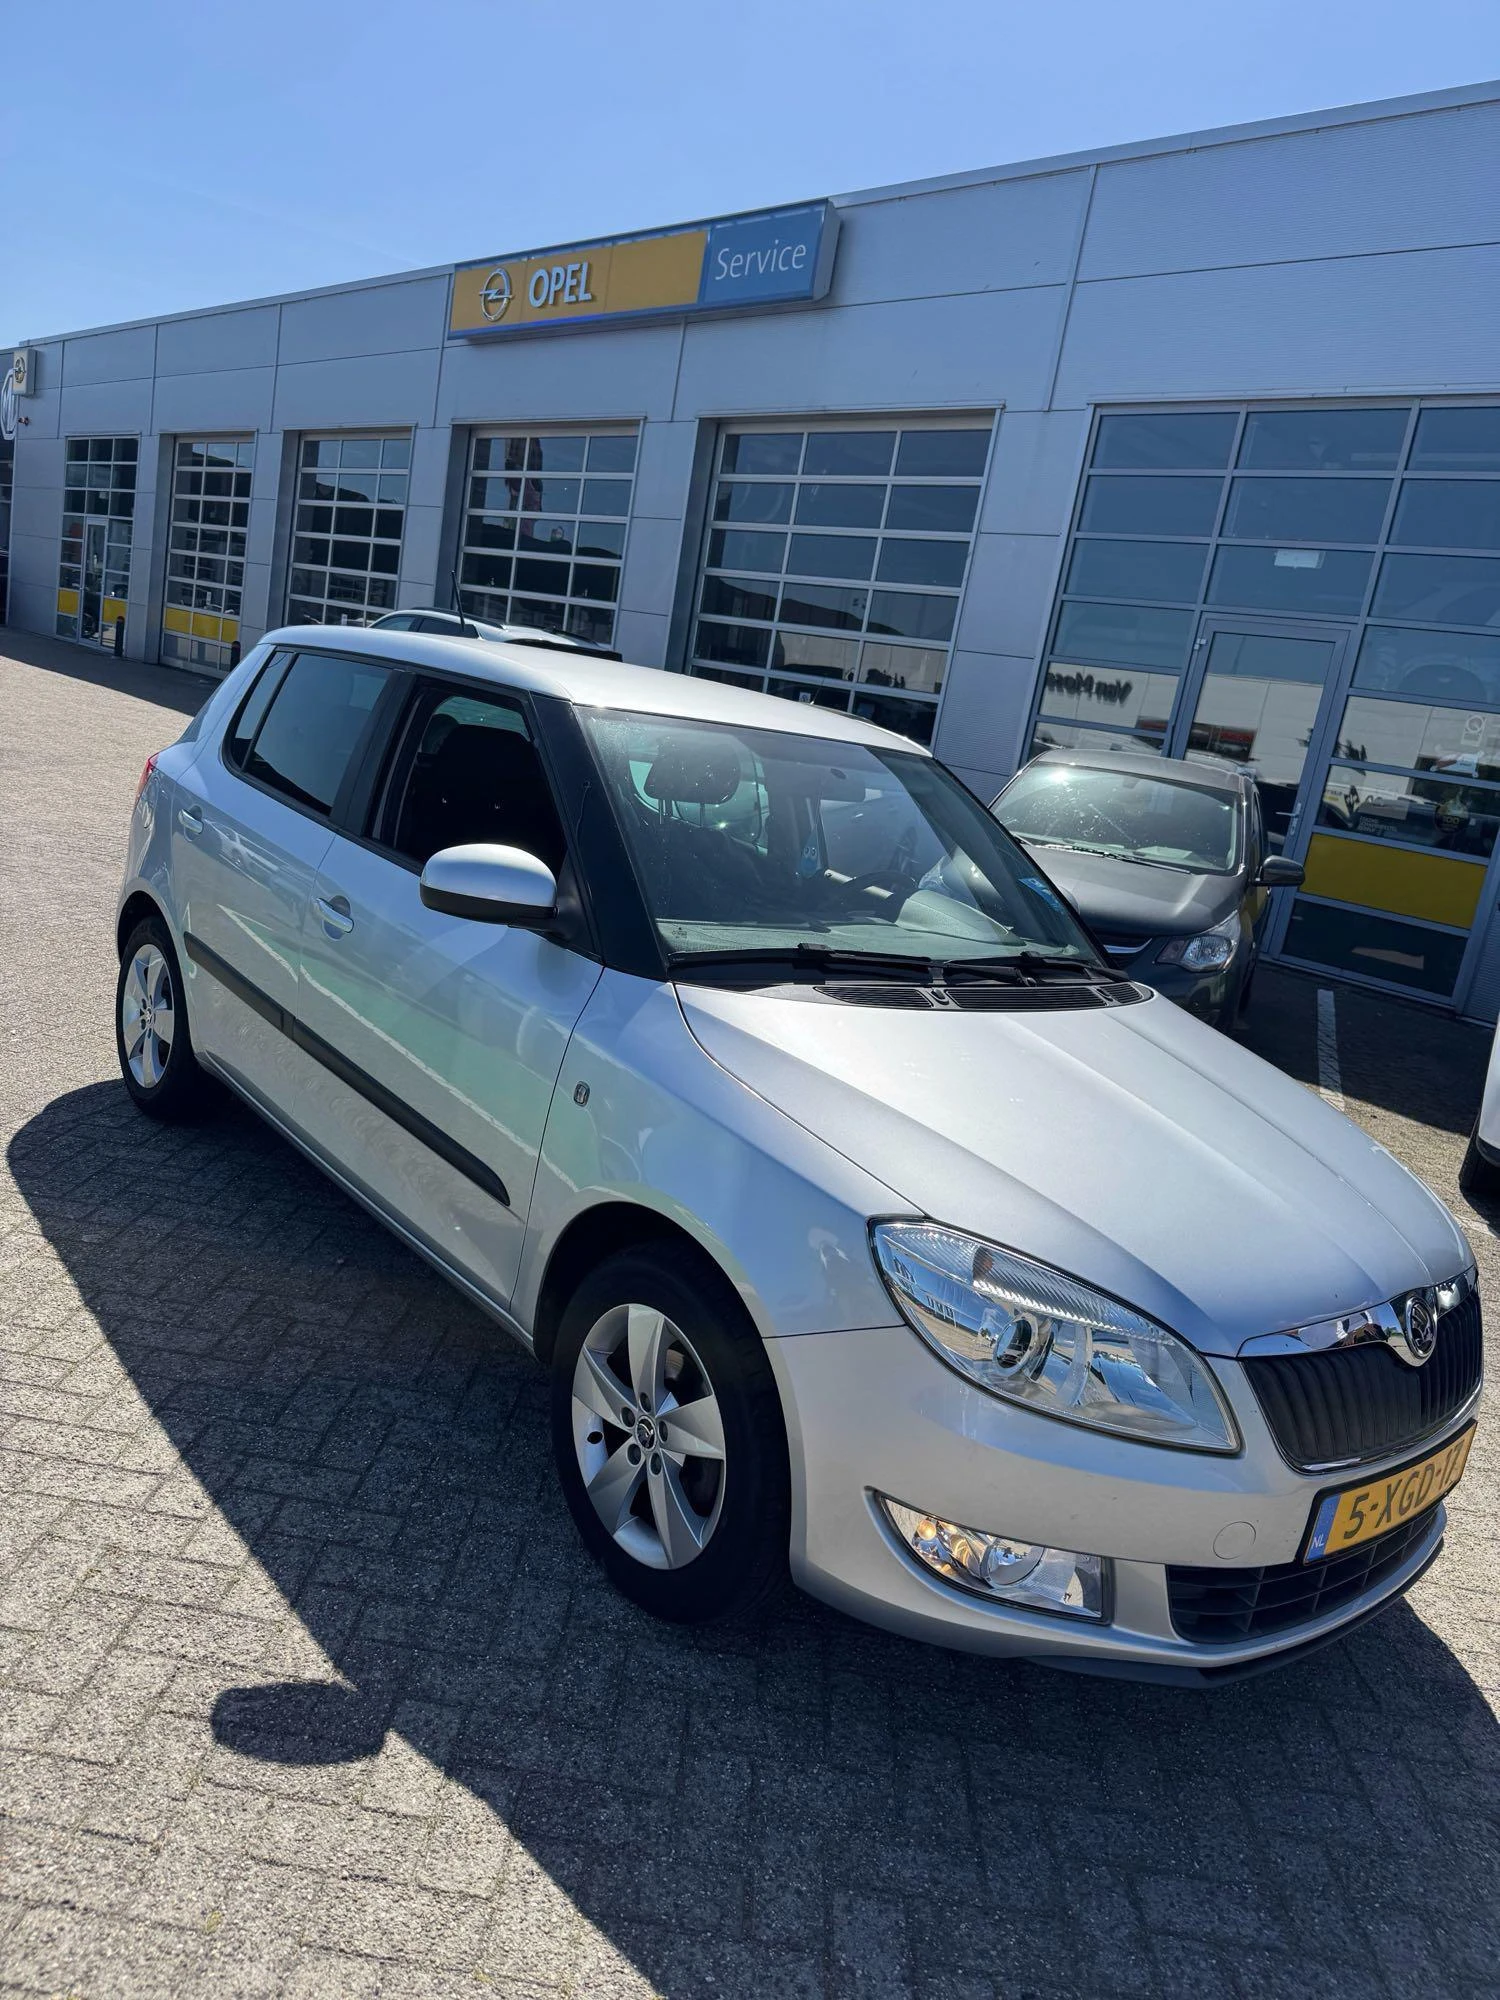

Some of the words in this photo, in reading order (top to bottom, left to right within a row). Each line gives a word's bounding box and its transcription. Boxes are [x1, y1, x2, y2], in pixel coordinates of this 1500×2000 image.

[529, 262, 592, 308] OPEL
[715, 239, 806, 281] Service
[1311, 1534, 1325, 1549] NL
